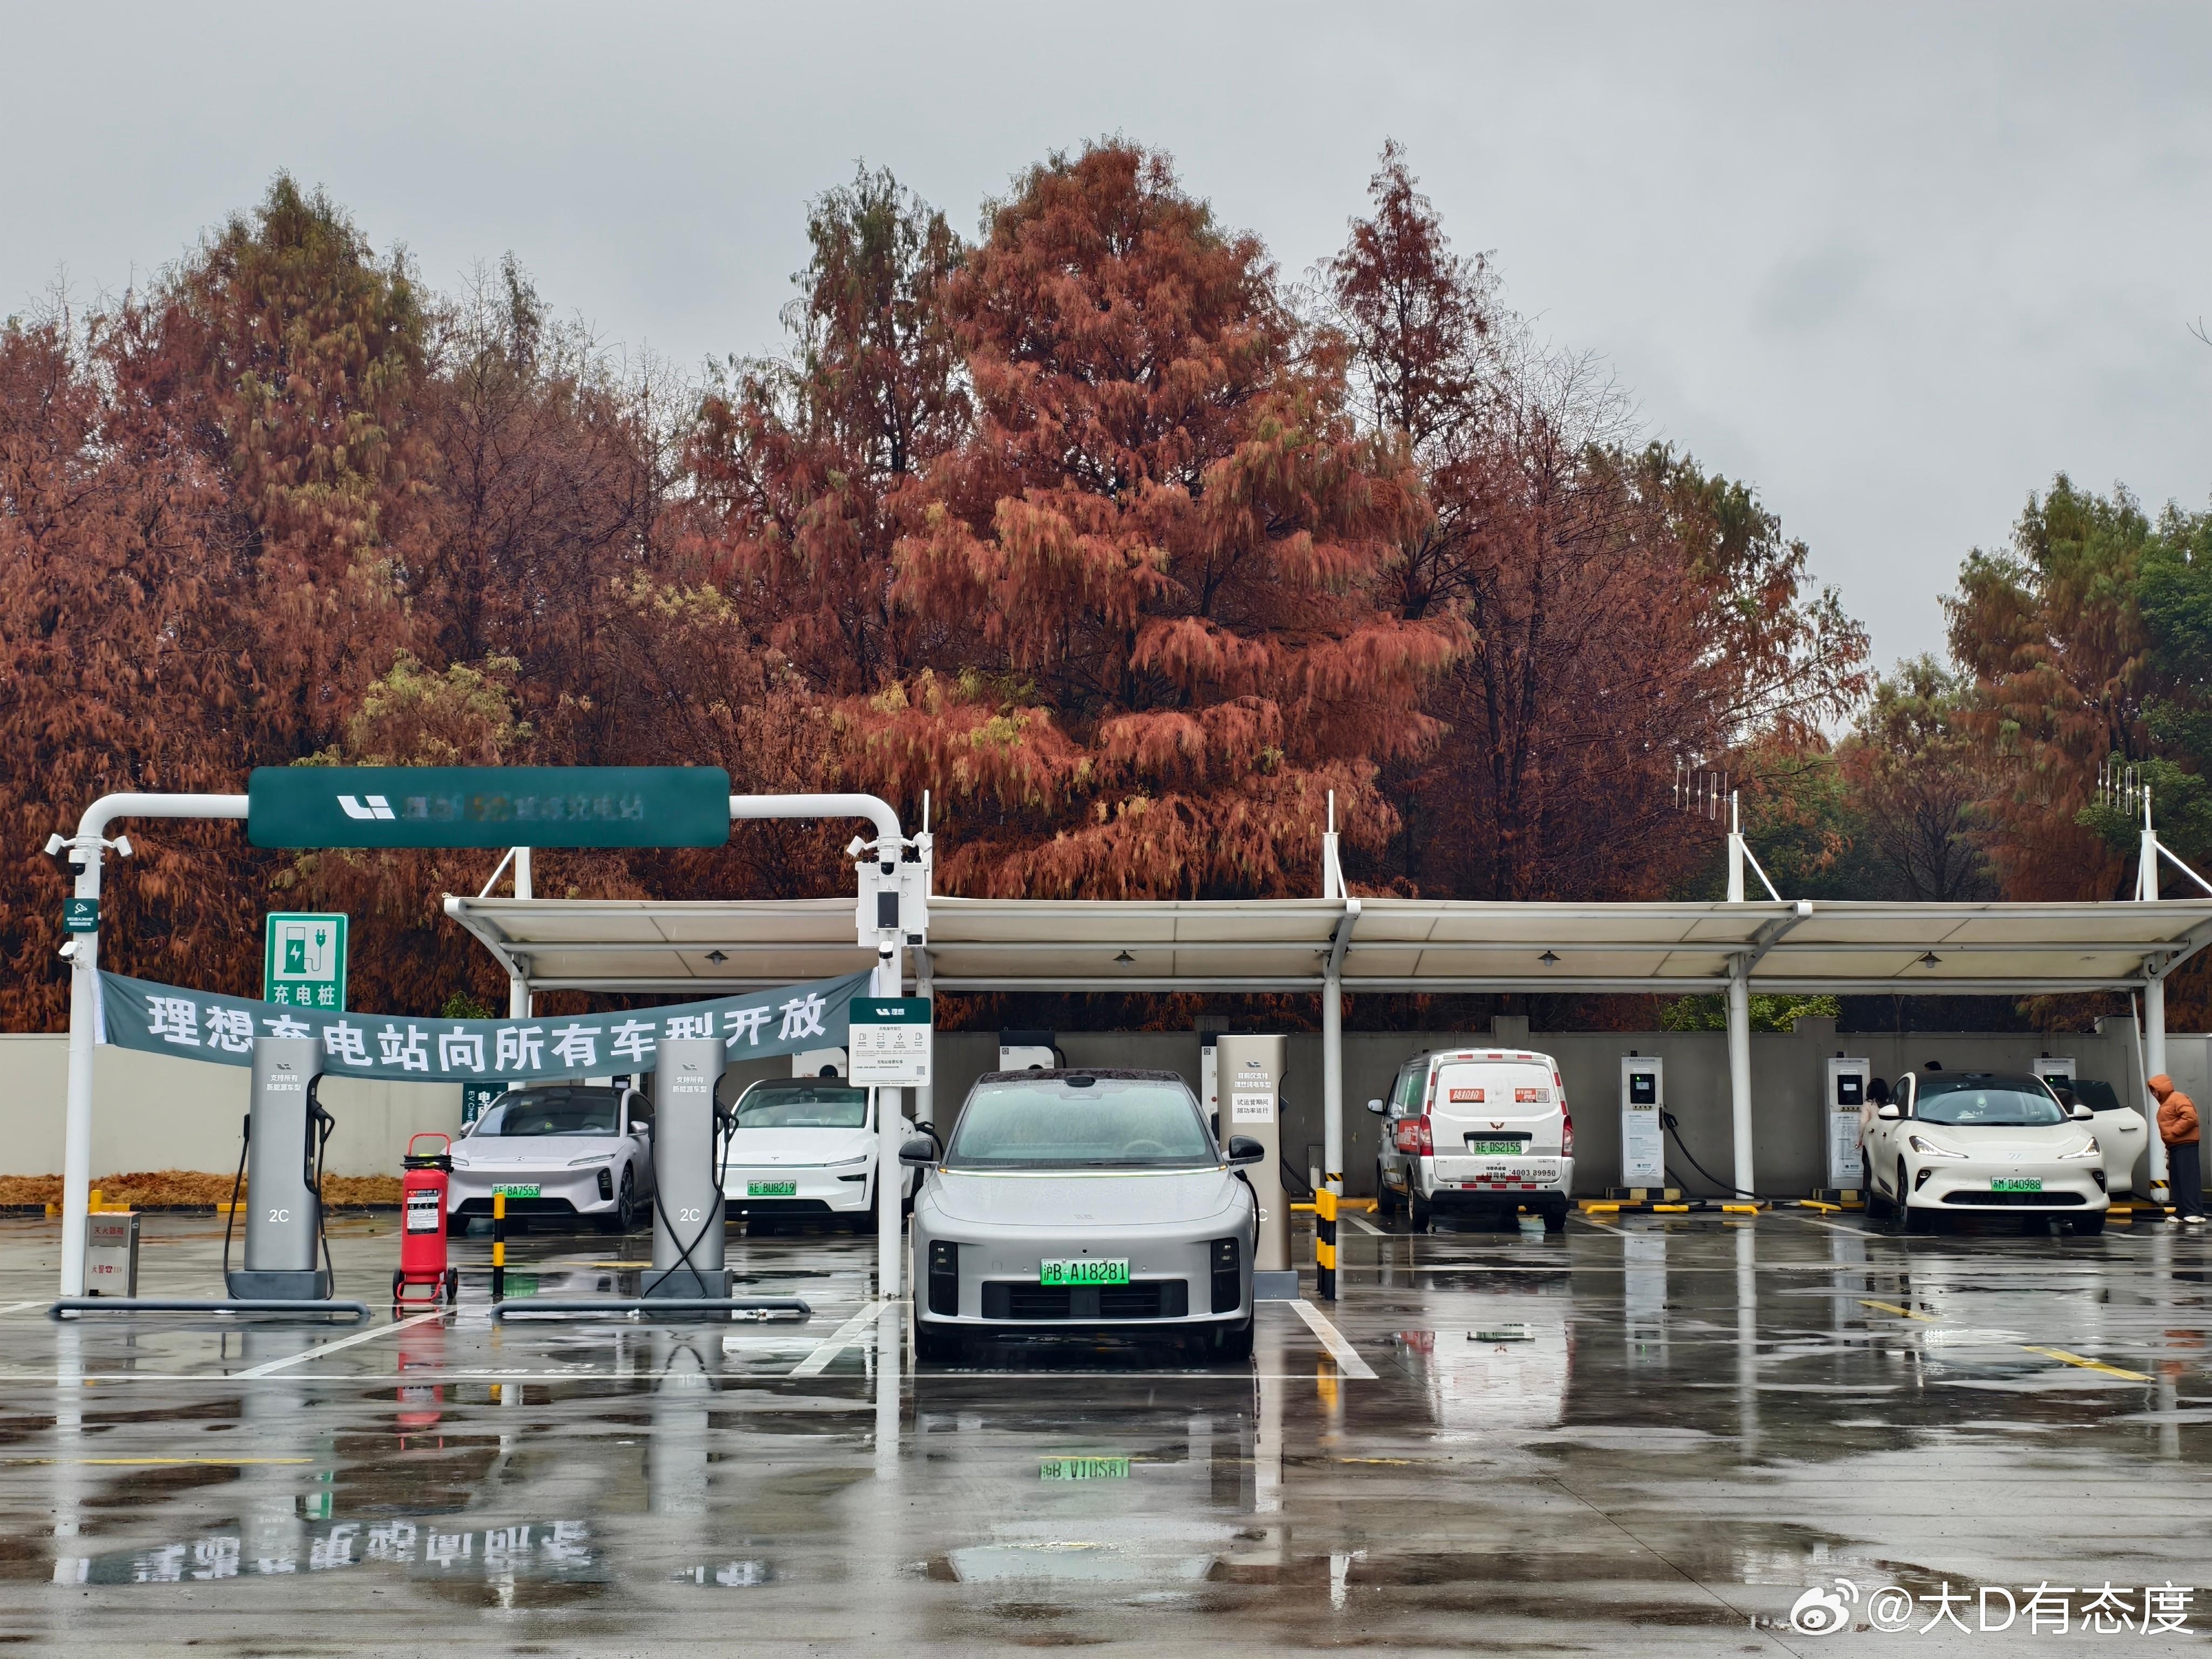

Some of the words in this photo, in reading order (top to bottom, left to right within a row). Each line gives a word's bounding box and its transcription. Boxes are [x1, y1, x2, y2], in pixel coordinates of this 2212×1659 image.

[274, 984, 335, 1005] 充电桩
[269, 1209, 289, 1222] 2C
[680, 1208, 700, 1221] 2C
